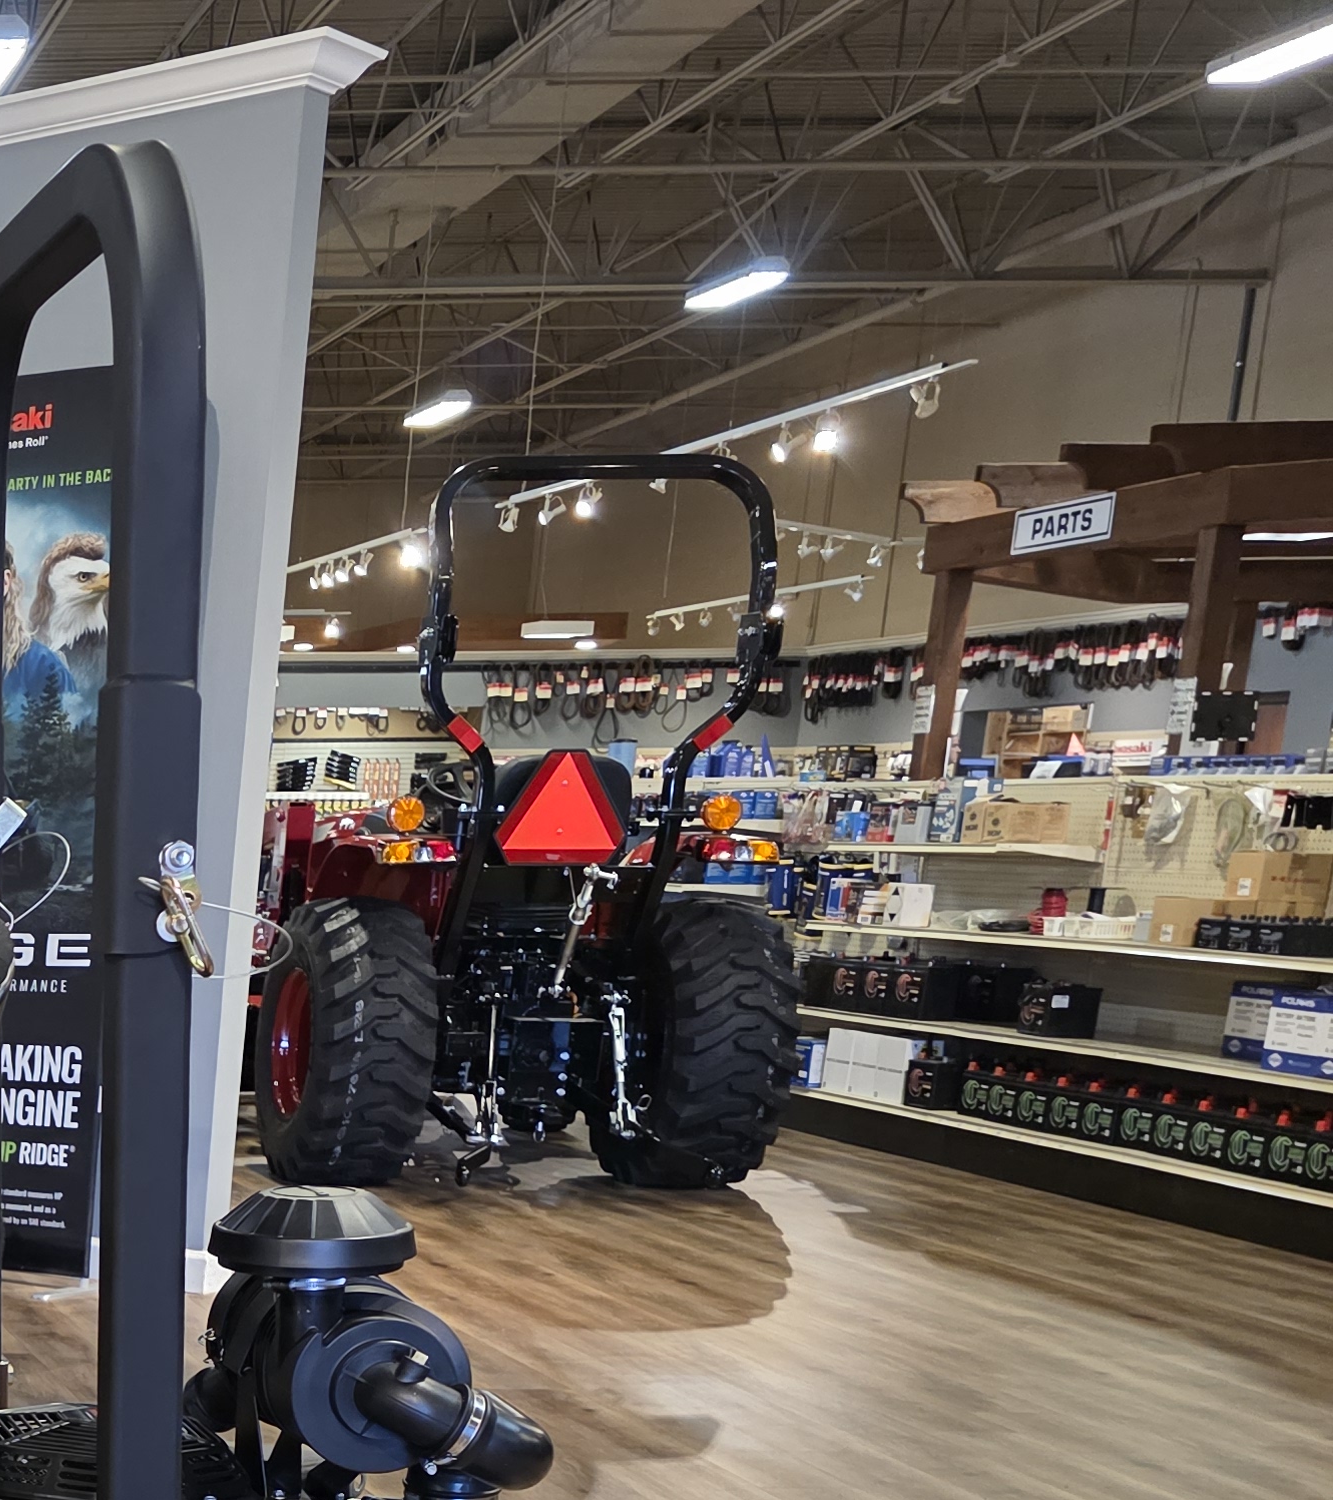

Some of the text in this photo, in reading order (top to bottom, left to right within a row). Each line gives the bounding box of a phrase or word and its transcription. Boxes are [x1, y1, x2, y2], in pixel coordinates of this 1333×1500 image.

[25, 435, 45, 448] Roll
[7, 475, 39, 492] ARTY
[42, 473, 55, 488] IN
[58, 470, 82, 487] THE
[85, 467, 112, 484] BAC
[1030, 507, 1094, 541] PARTS
[8, 978, 68, 993] RMANCE
[0, 1043, 83, 1084] AKING
[0, 1087, 82, 1129] NGINE
[18, 1141, 70, 1167] RIDGE
